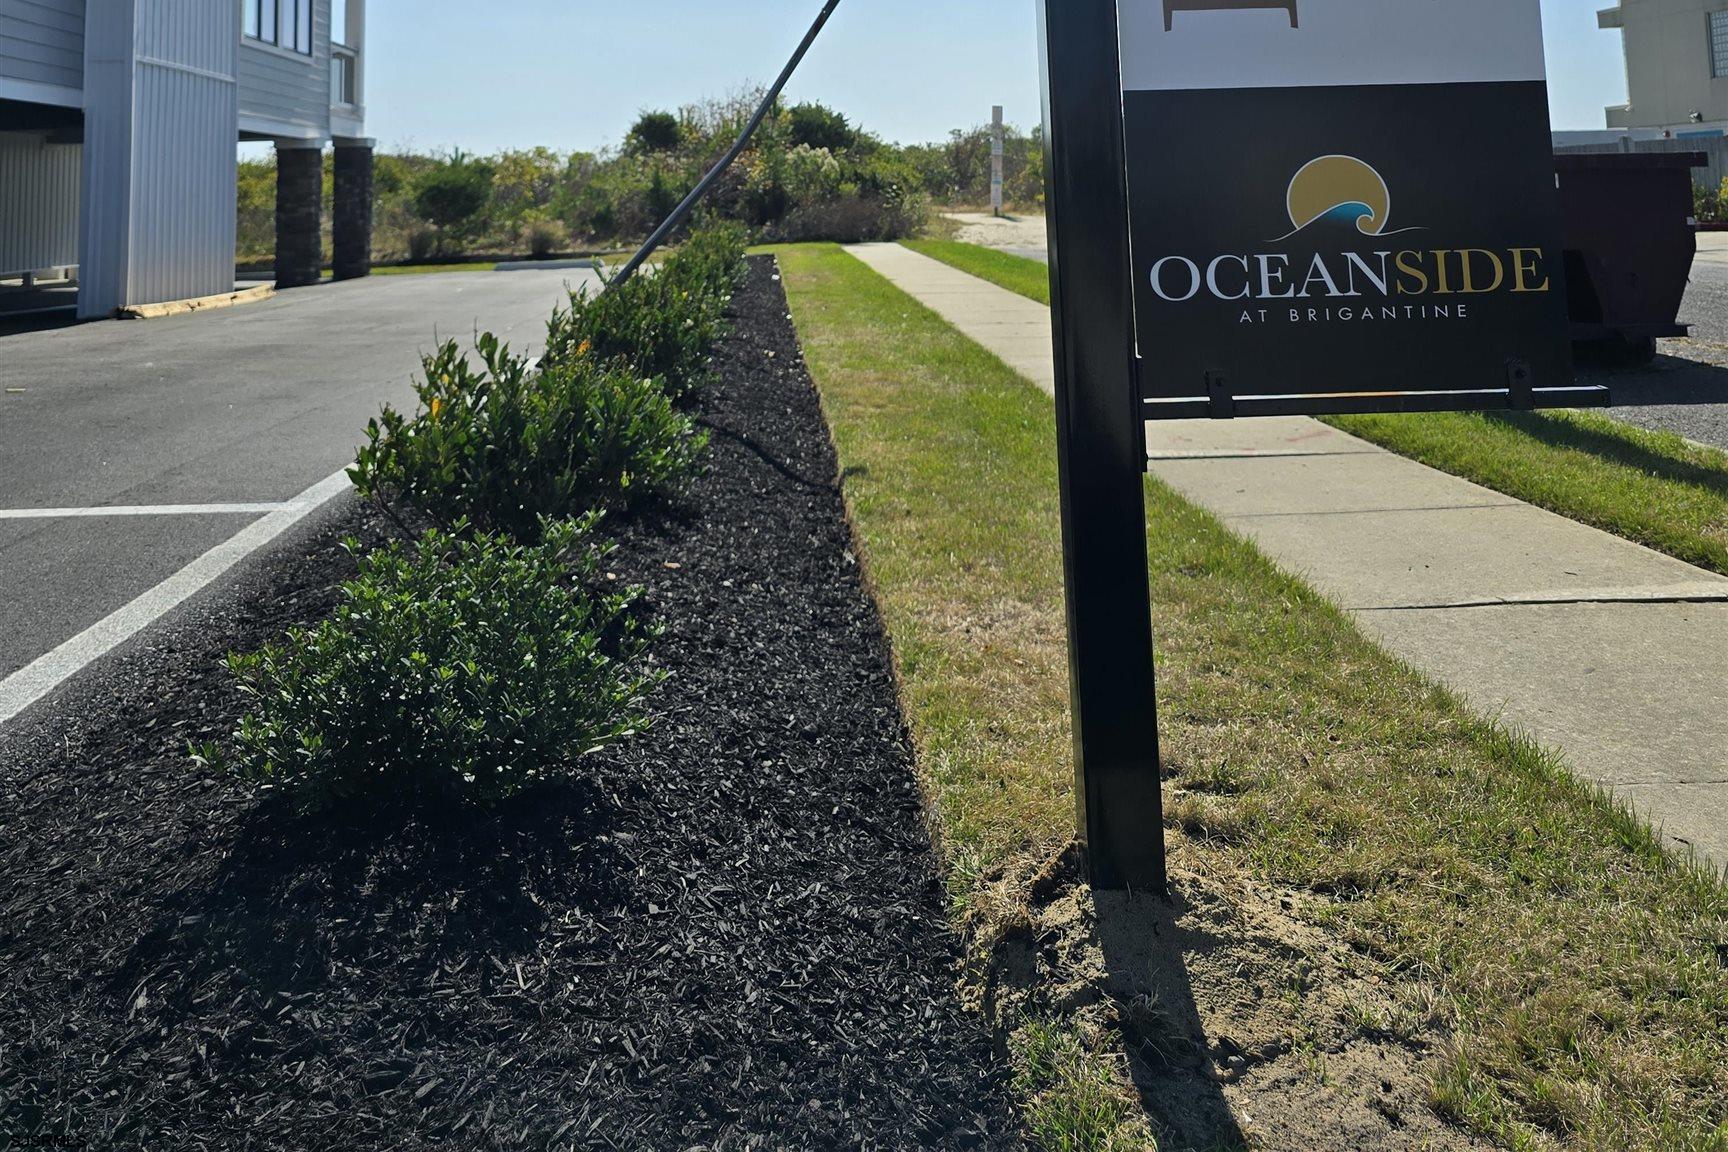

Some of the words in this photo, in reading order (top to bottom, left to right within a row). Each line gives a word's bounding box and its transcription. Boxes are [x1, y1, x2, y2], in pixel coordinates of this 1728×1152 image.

[1149, 247, 1549, 302] OCEANSIDE
[1239, 308, 1269, 323] AT
[1289, 303, 1468, 323] BRIGANTINE
